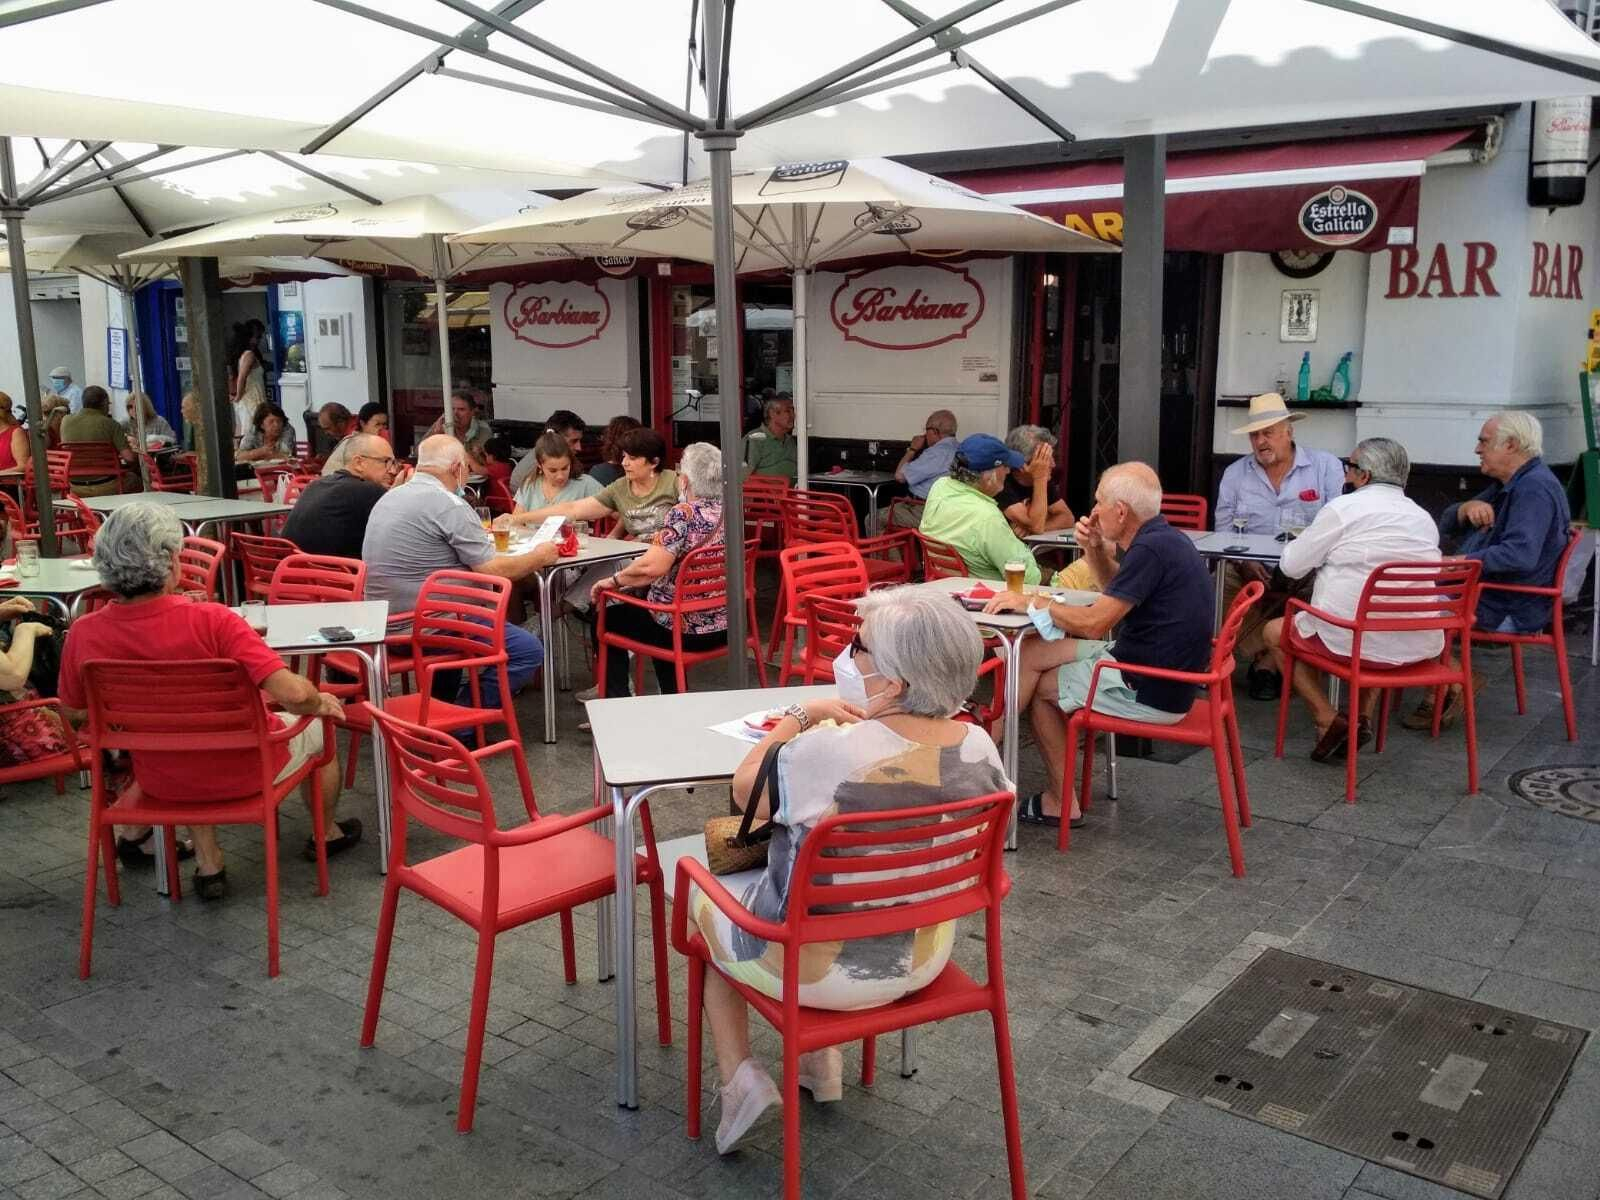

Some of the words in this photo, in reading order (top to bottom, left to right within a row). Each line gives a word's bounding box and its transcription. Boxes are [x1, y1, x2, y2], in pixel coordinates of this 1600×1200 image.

[1309, 202, 1367, 219] Estrella
[1312, 217, 1364, 232] Galicia
[1384, 242, 1501, 299] BAR
[1528, 241, 1584, 299] BAR
[512, 296, 600, 328] Barbiana
[841, 287, 969, 326] Barbiana
